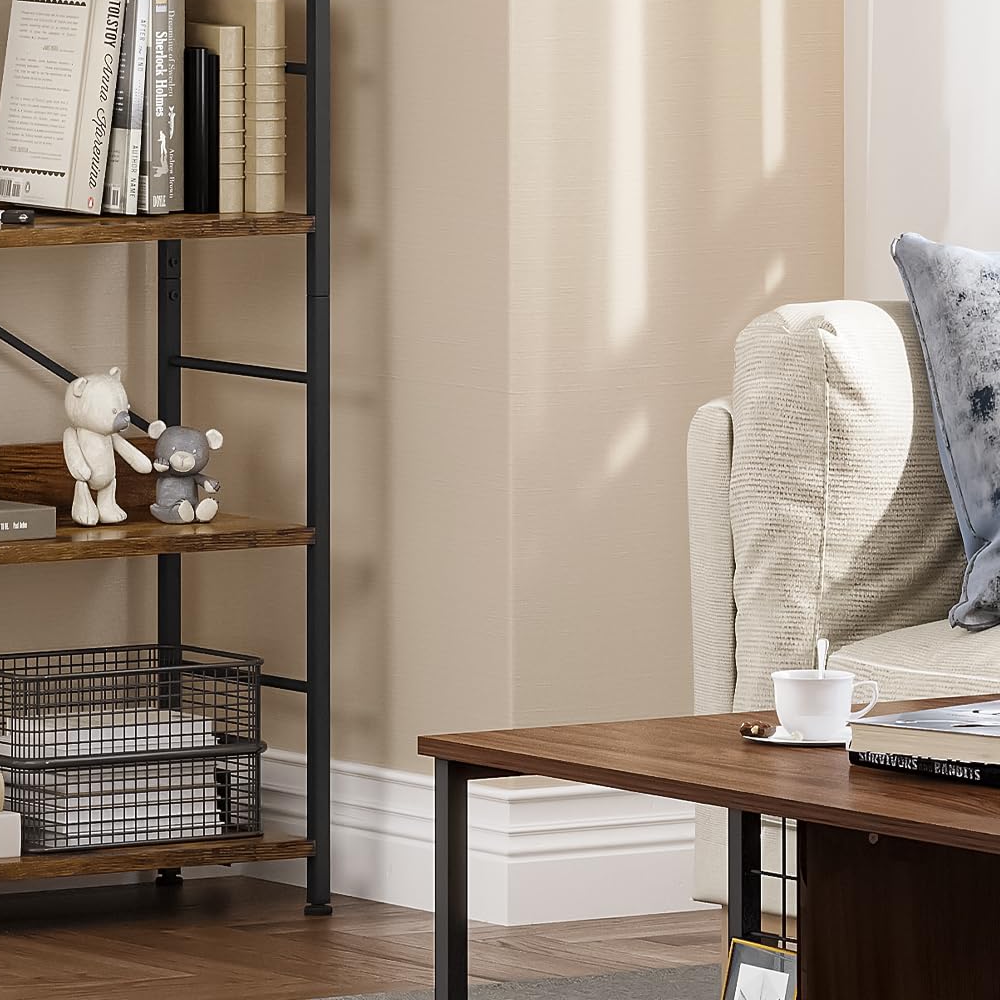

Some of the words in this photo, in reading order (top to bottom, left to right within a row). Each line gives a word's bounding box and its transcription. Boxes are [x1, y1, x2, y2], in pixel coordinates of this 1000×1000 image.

[103, 1, 121, 49] TOLSTOY
[155, 31, 168, 77] Sherlock
[99, 53, 113, 103] Anna
[168, 64, 176, 97] Sweden
[155, 79, 168, 117] Holmes
[88, 107, 107, 190] Karenina
[131, 145, 139, 173] AUTHOR
[129, 177, 137, 198] NAME
[934, 761, 981, 781] BANDITS
